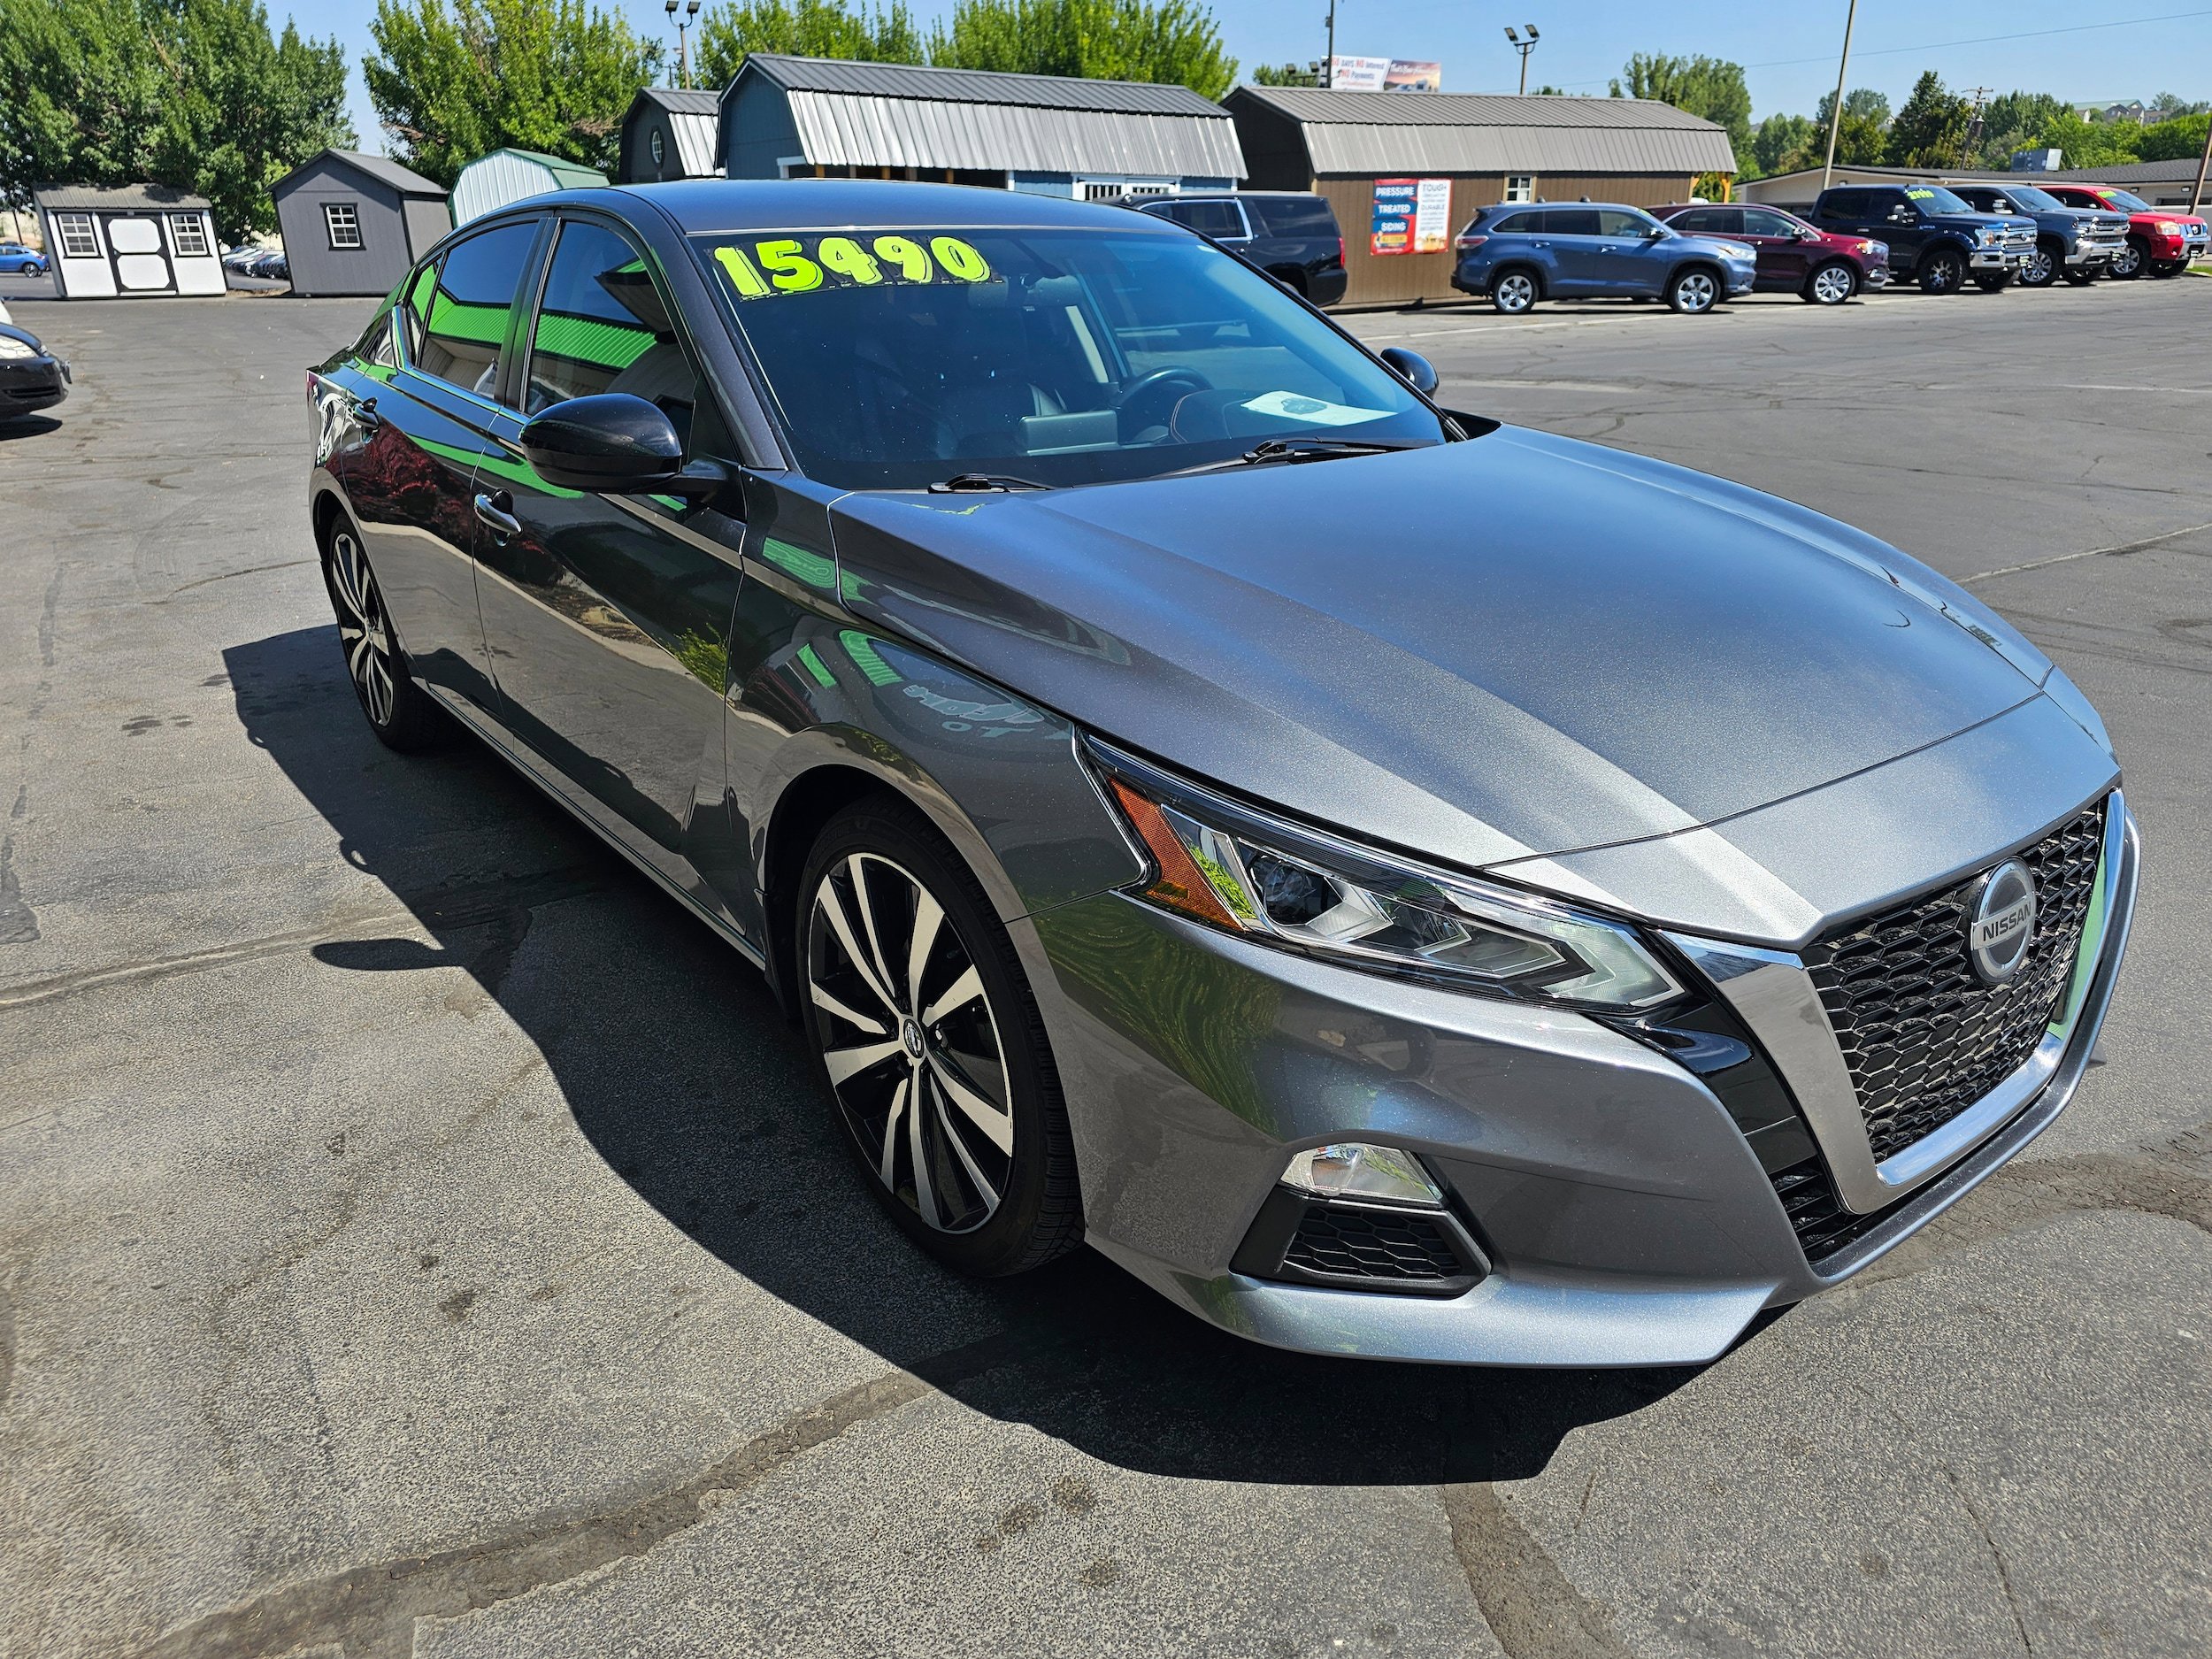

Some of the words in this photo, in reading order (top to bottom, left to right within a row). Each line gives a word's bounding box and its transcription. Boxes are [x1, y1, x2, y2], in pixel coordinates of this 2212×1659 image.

[1376, 187, 1415, 197] PRESSURE
[1379, 204, 1411, 214] TREATED
[1381, 222, 1407, 232] SIDING
[714, 235, 991, 296] 15490
[1983, 902, 2032, 942] NISSAN
